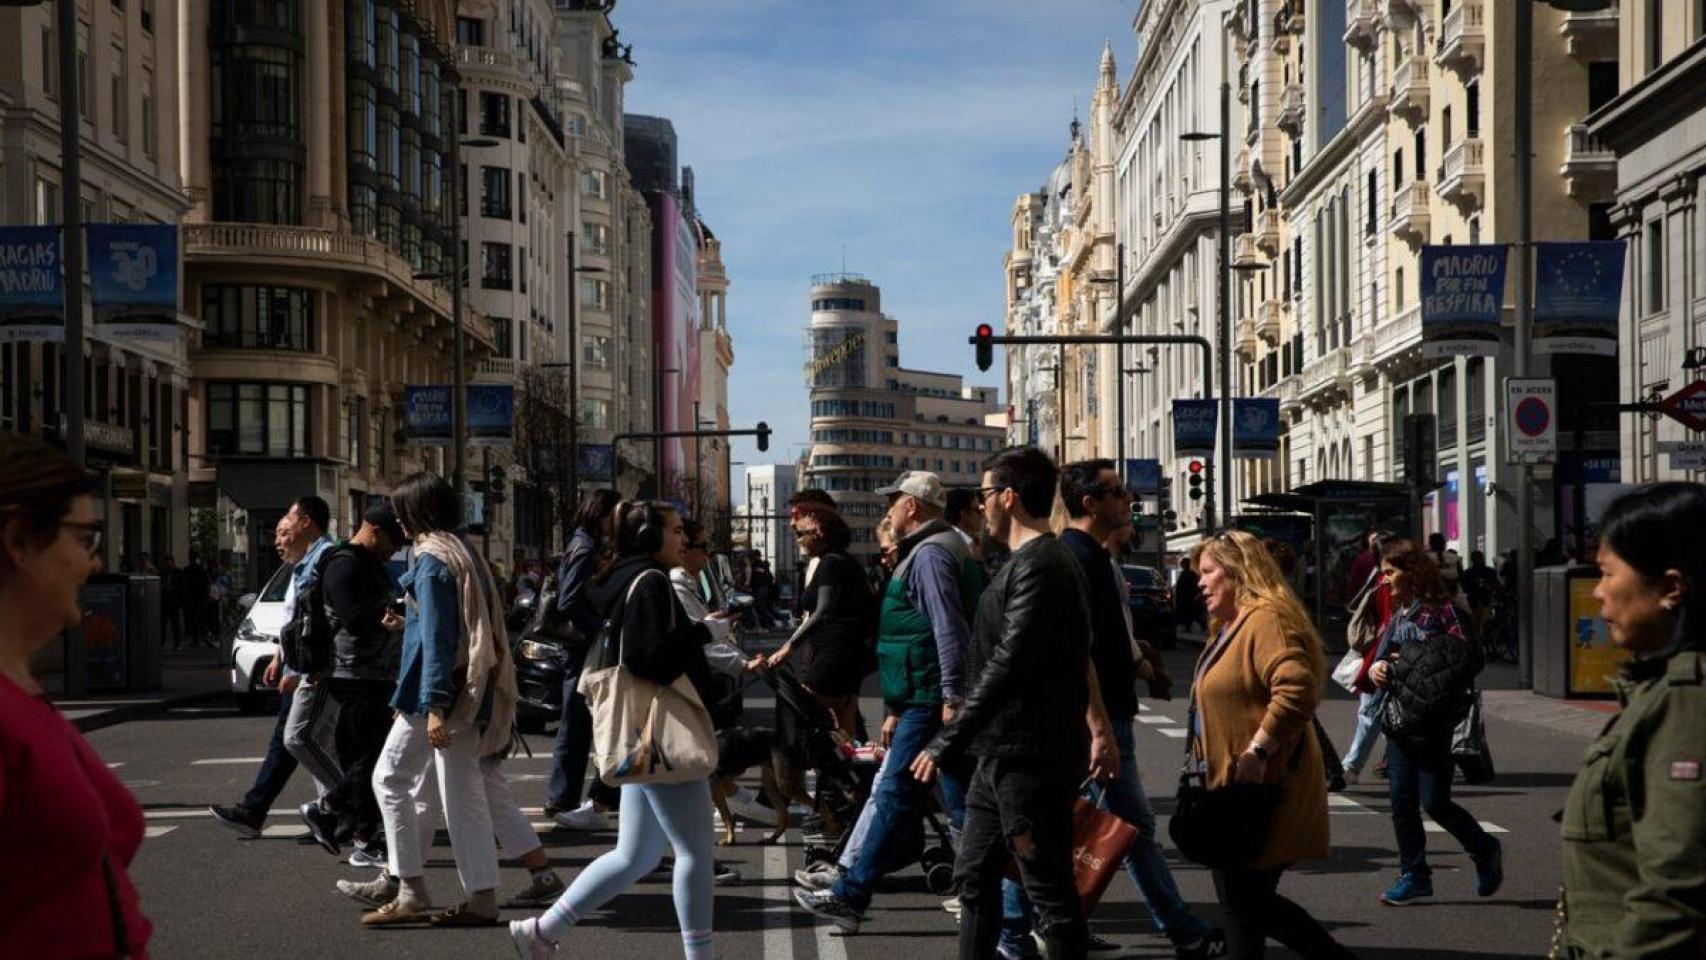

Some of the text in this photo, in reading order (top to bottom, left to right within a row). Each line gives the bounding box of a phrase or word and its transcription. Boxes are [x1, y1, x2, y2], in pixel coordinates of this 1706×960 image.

[1432, 253, 1499, 278] MADRID
[1436, 277, 1488, 294] POR FIN
[1424, 293, 1497, 318] RESPIRA
